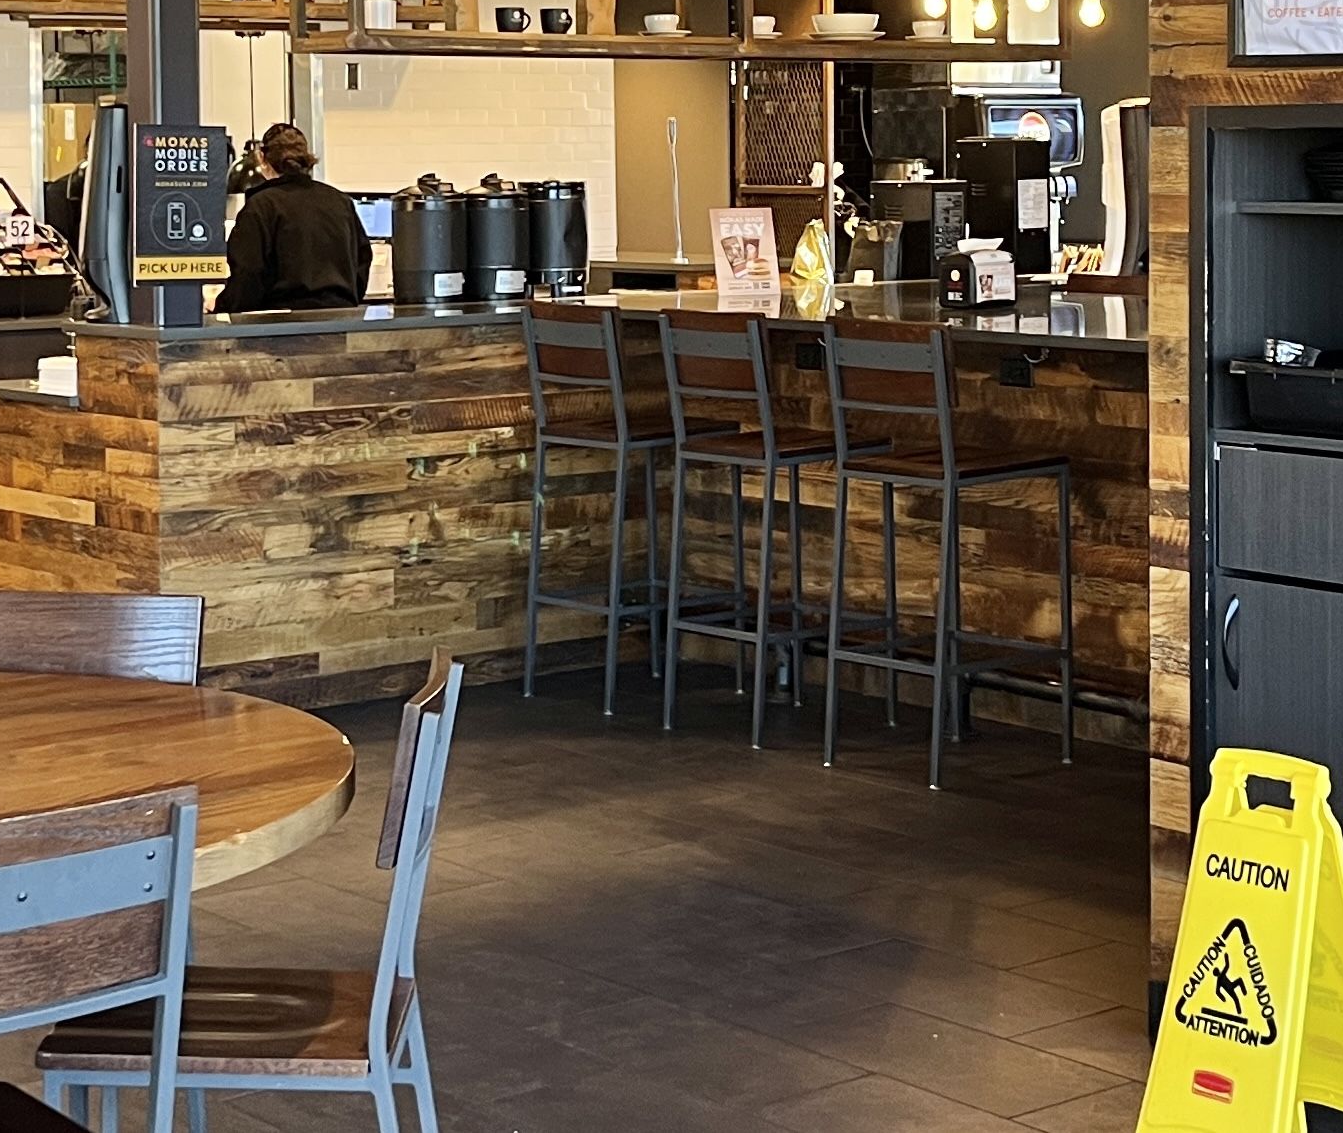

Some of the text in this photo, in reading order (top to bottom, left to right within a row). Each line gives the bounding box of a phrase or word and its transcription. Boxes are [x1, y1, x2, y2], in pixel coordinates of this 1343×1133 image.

[1267, 7, 1307, 18] COFFEE
[155, 136, 209, 148] MOKAS
[155, 148, 208, 160] MOBILE
[154, 160, 209, 172] ORDER
[10, 220, 30, 237] 52
[719, 223, 765, 237] EASY
[138, 262, 223, 273] PICK UP HERE
[1206, 853, 1289, 892] CAUTION
[1182, 935, 1227, 998] CAUTION
[1243, 943, 1276, 1019] CUIDADO
[1185, 1014, 1260, 1047] ATTENTION
